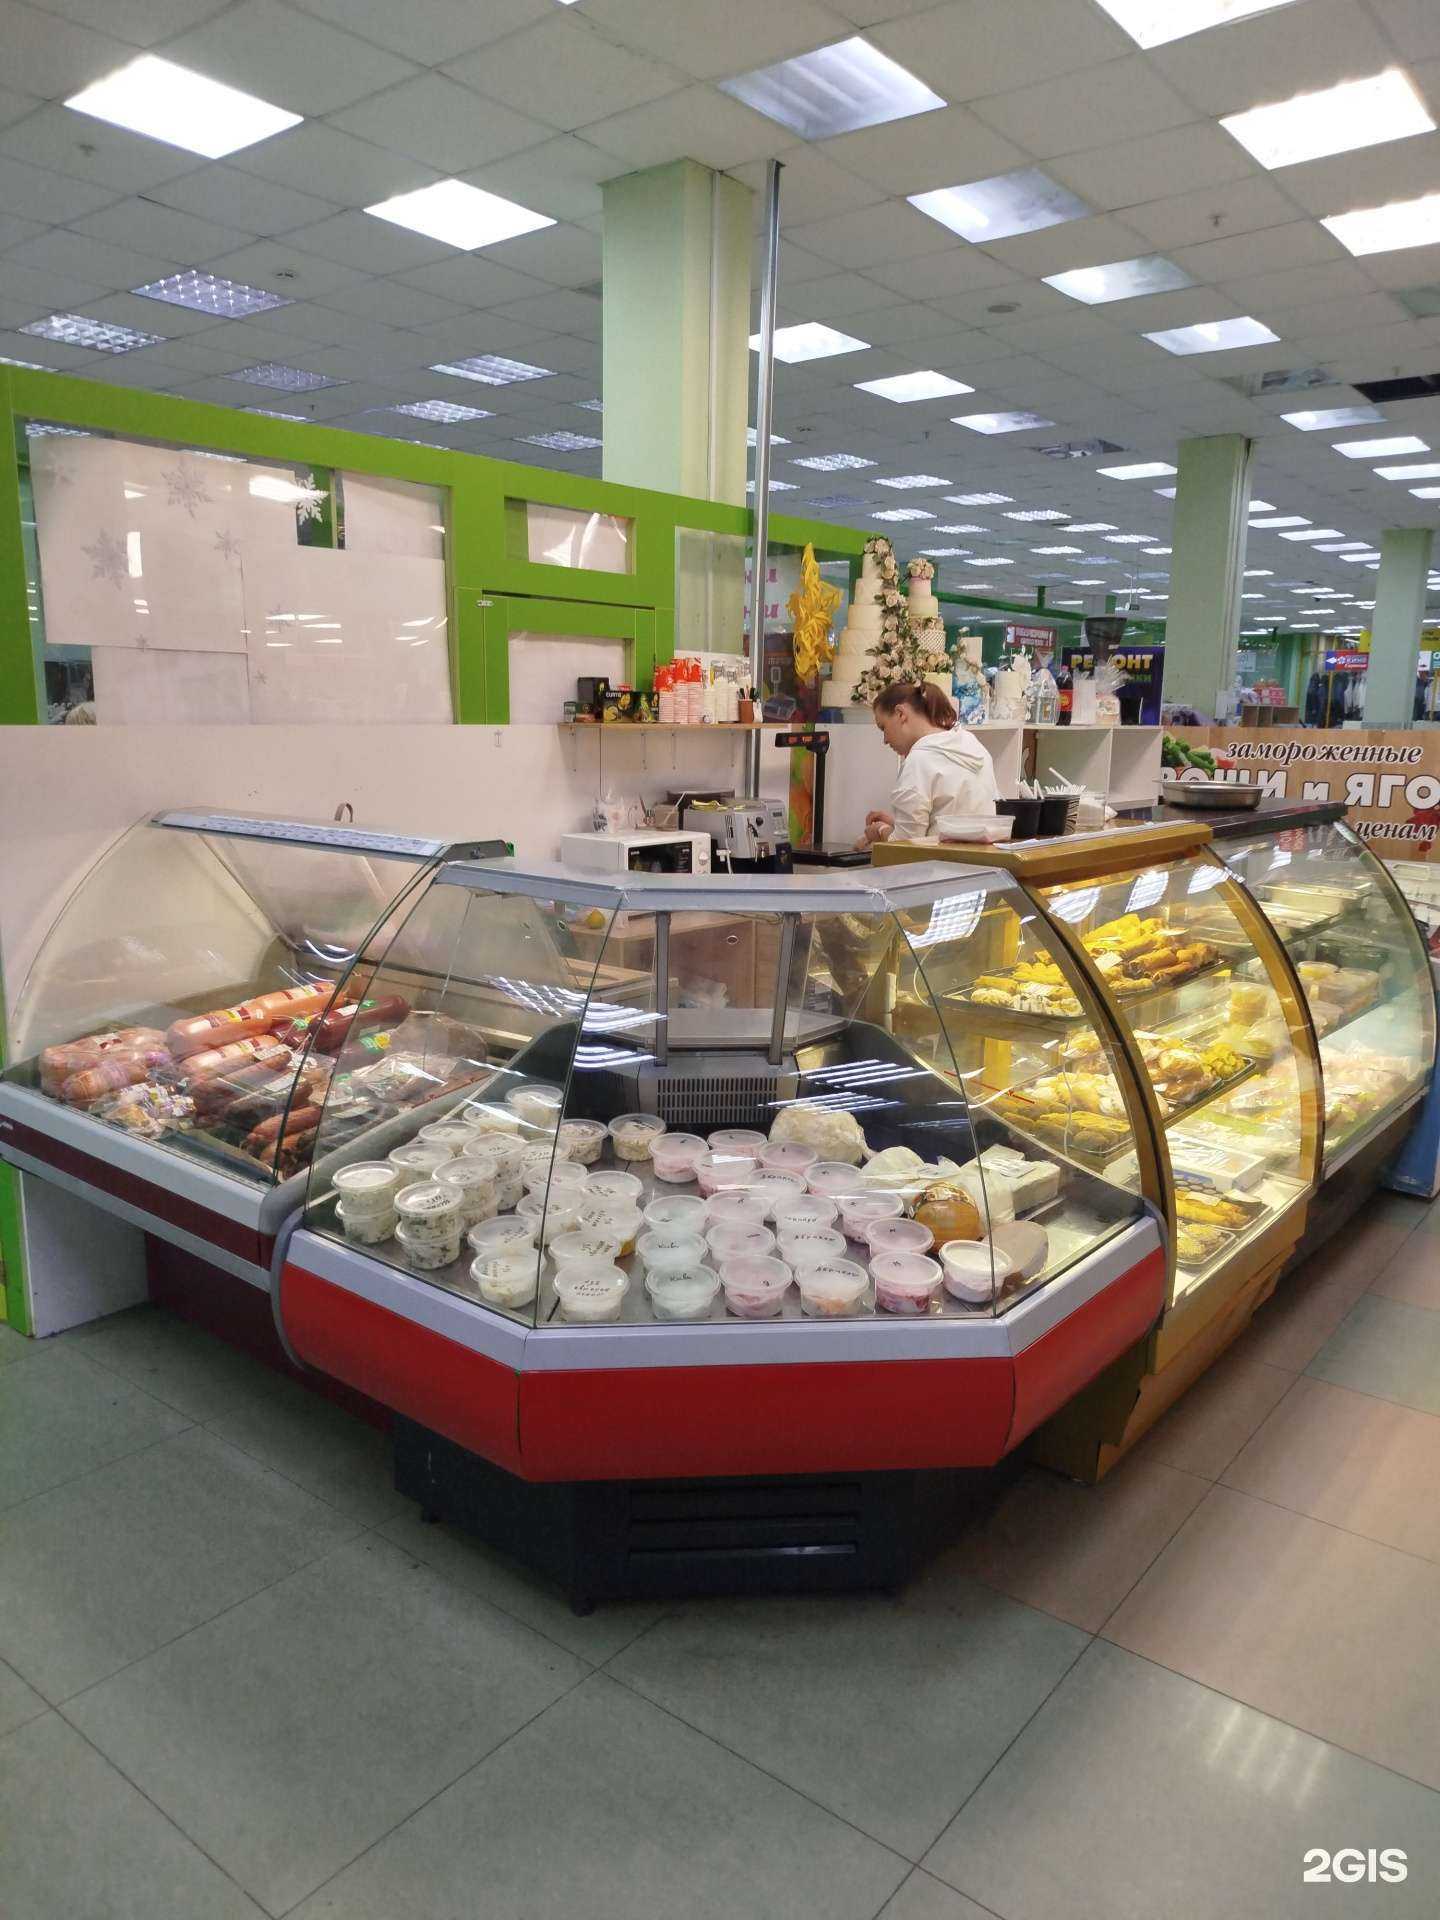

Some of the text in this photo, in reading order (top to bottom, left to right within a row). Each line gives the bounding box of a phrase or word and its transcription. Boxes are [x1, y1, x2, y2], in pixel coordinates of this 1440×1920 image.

[1071, 654, 1153, 670] РЕОНТ
[1225, 741, 1423, 767] замороженные
[1355, 822, 1436, 841] ценам
